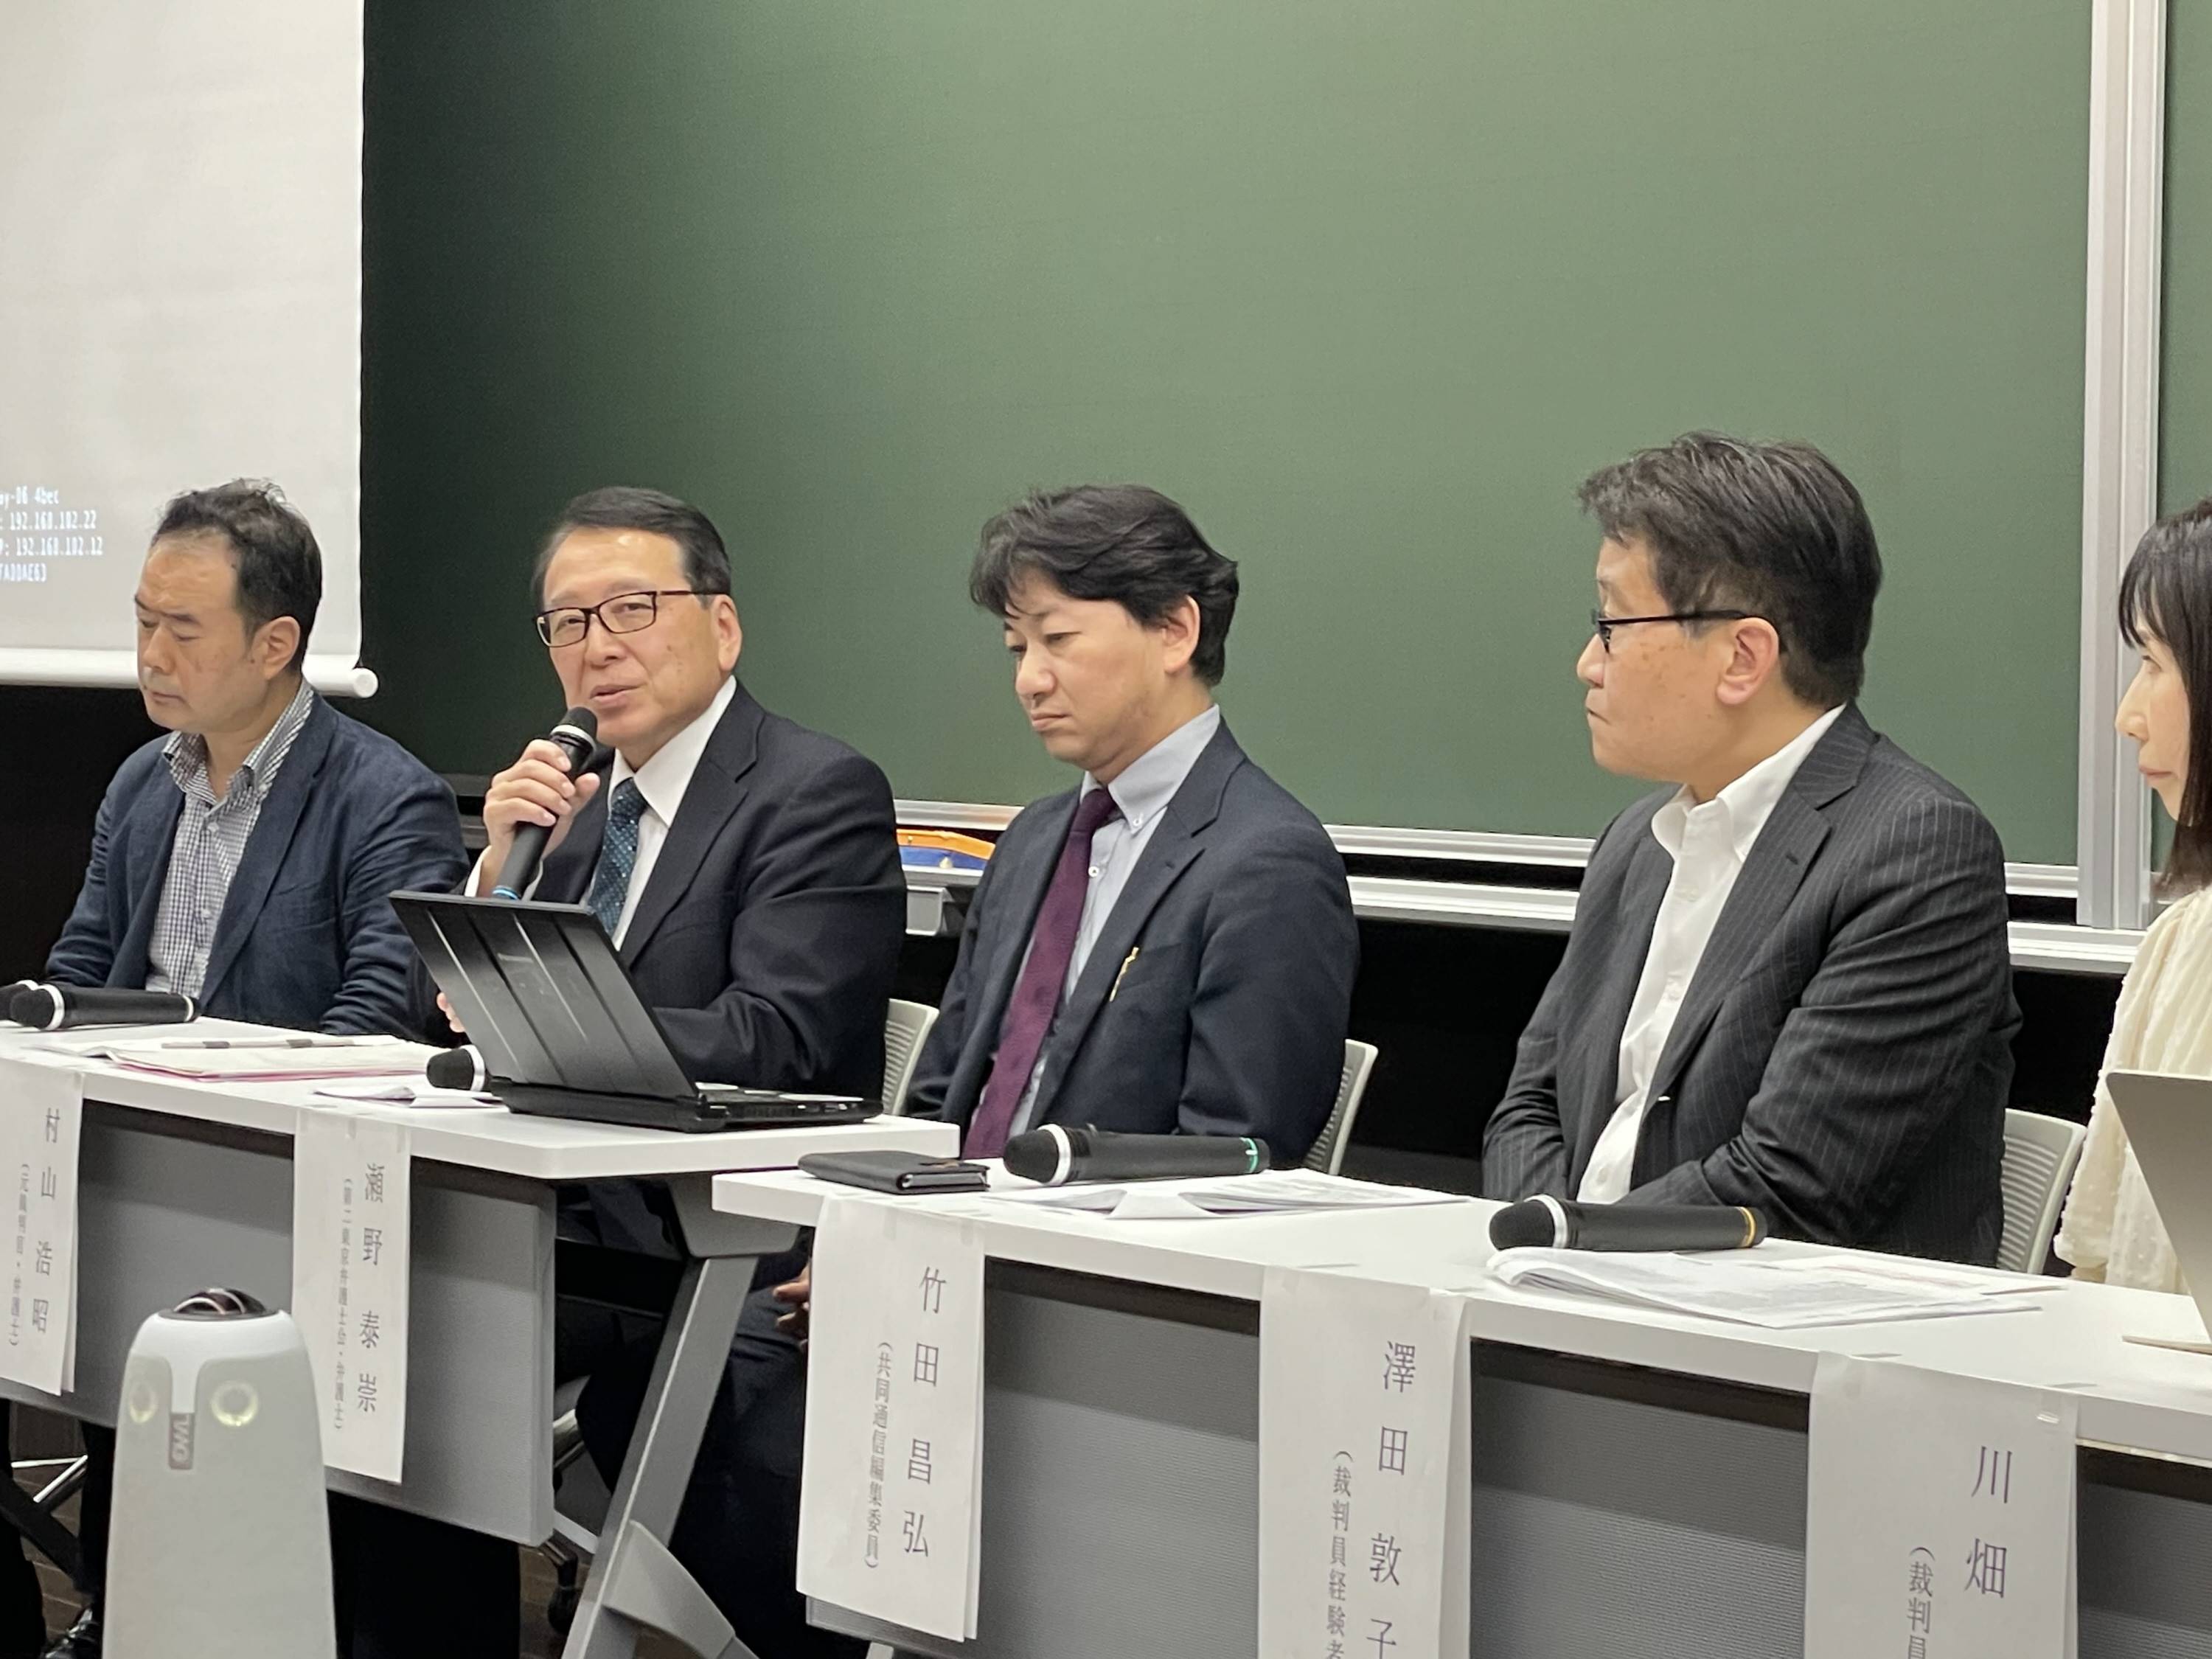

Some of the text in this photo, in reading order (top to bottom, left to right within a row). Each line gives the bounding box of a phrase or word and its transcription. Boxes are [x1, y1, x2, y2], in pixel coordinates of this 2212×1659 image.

[902, 1267, 947, 1557] 竹田昌弘
[1366, 1340, 1416, 1659] 澤田敦子
[1964, 1446, 2012, 1598] 川畑
